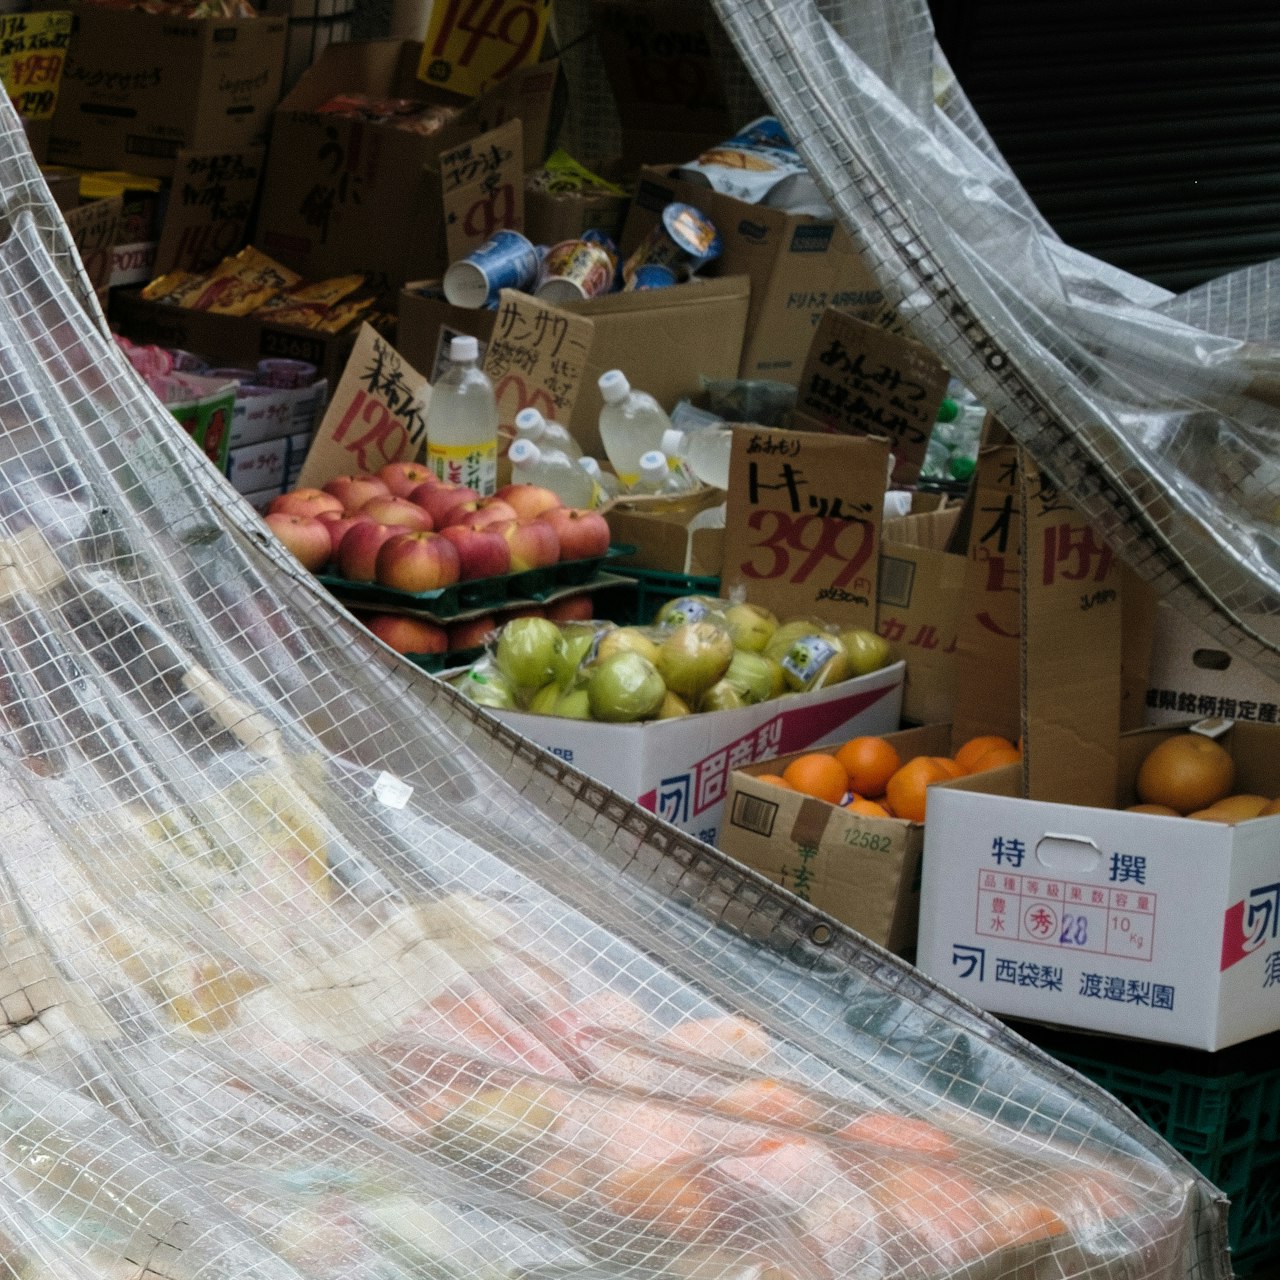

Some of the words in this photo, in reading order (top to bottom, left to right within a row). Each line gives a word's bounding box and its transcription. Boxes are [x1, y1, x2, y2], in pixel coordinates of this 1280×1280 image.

[740, 509, 876, 590] 399
[843, 827, 893, 864] 12582
[991, 836, 1026, 868] 特
[1109, 852, 1147, 886] 撰
[984, 873, 1016, 892] 品種
[1027, 880, 1060, 898] 等級
[1115, 893, 1151, 911] 容量
[990, 896, 1007, 933] 豊水
[1031, 908, 1053, 935] 秀
[1059, 913, 1090, 945] 28
[1112, 916, 1131, 933] 10
[995, 957, 1063, 992] 西袋梨
